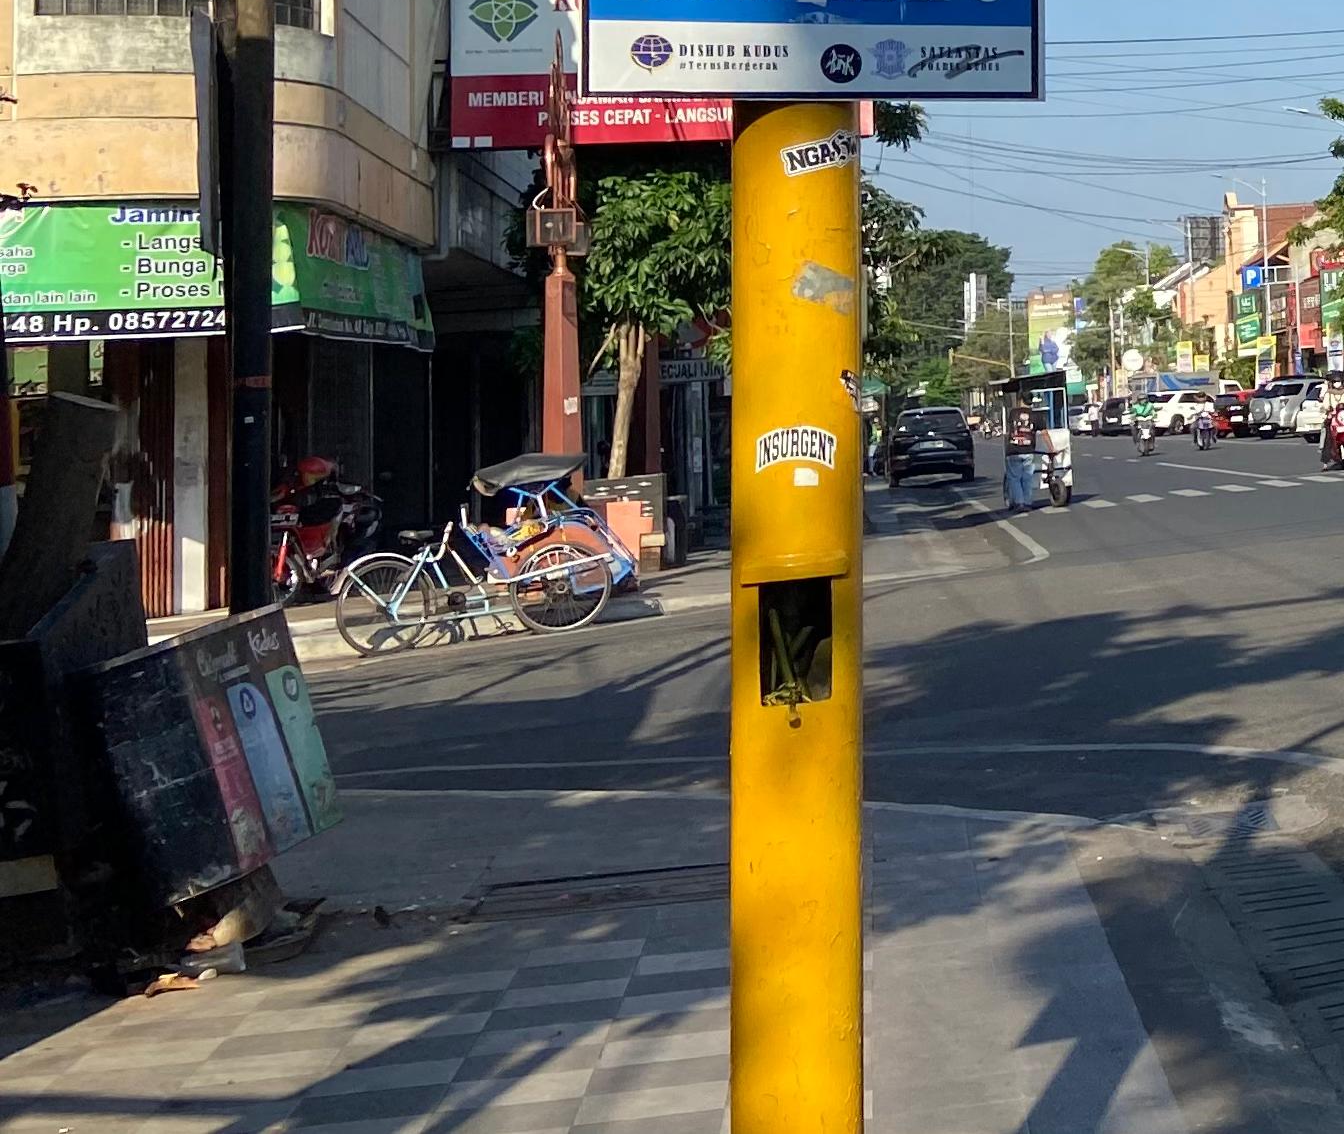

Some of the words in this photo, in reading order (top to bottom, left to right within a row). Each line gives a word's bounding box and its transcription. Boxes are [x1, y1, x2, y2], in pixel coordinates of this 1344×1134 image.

[679, 43, 736, 57] DISHUB
[743, 44, 790, 58] KUDUS
[468, 91, 544, 108] MEMBERI
[603, 108, 653, 126] CEPAT
[138, 258, 207, 278] Bunga
[1246, 269, 1257, 285] P
[36, 291, 64, 304] lain
[68, 291, 96, 303] lain
[136, 280, 210, 300] Proses
[54, 313, 99, 335] Hp.
[758, 428, 835, 470] INSURGENT
